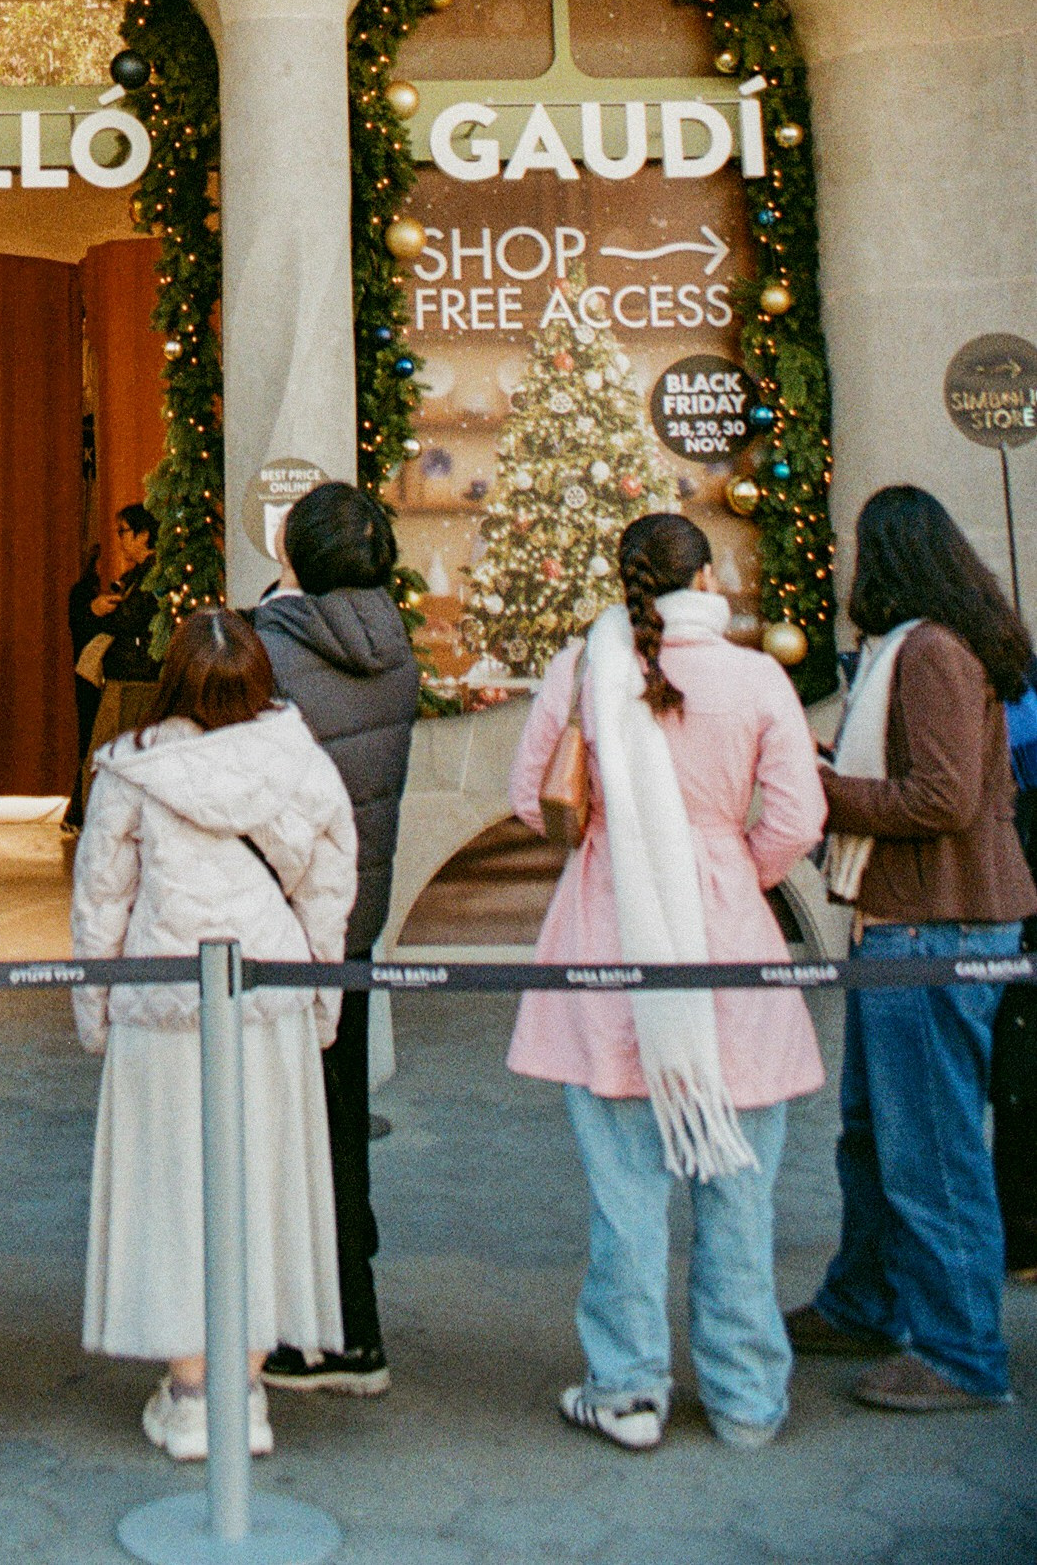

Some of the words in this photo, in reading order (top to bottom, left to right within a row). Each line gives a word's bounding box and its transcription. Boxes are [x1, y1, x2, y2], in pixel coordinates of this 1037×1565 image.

[429, 75, 767, 181] GAUDÍ
[414, 227, 586, 281] SHOP
[415, 288, 523, 330] FREE
[540, 284, 733, 329] ACCESS
[665, 372, 742, 394] BLACK
[663, 394, 746, 415] FRIDAY
[684, 437, 730, 453] NOV.
[261, 469, 286, 482] BEST
[288, 469, 321, 482] PRICE
